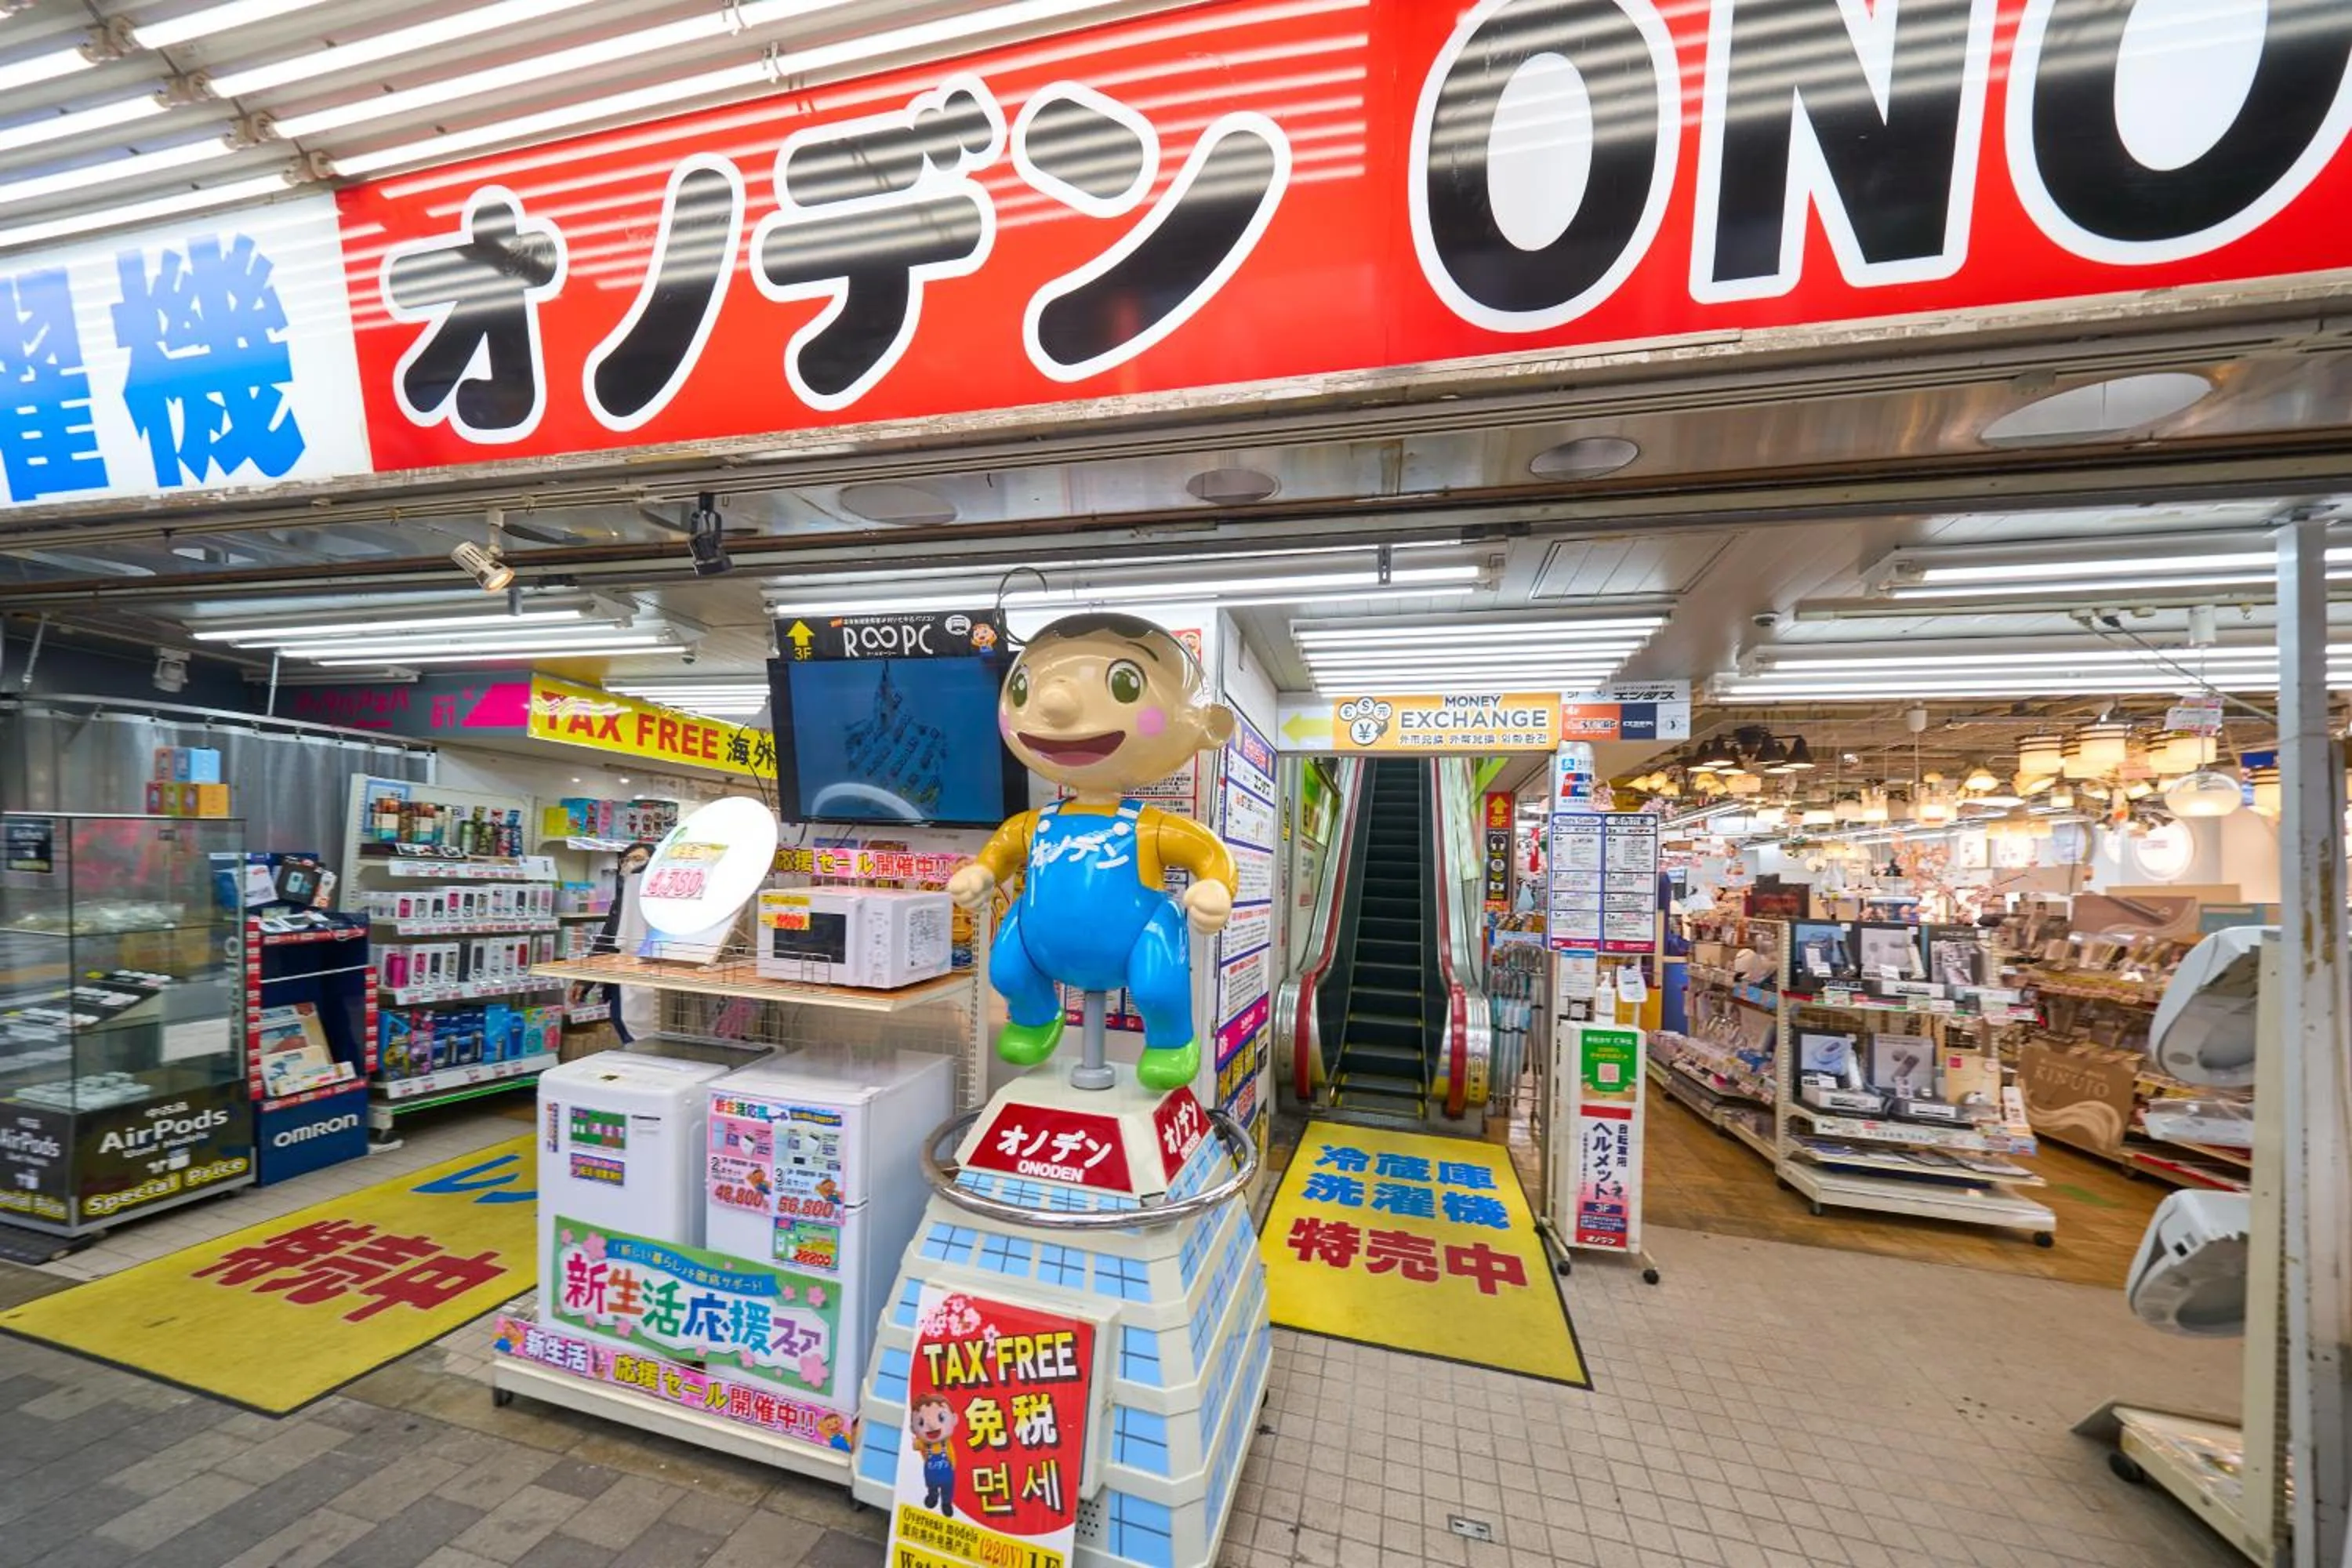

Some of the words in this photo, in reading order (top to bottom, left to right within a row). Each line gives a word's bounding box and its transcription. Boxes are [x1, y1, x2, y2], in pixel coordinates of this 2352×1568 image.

[379, 73, 1292, 443] オノデン
[793, 648, 811, 661] 3F
[540, 690, 622, 743] TAX
[635, 713, 719, 760] FREE
[1401, 710, 1548, 728] EXCHANGE
[1444, 695, 1501, 708] MONEY
[98, 1109, 229, 1154] AirPods
[996, 1124, 1112, 1168] オノデン
[1163, 1100, 1198, 1155] オノデン
[84, 1174, 177, 1214] Special
[186, 1156, 248, 1186] Price
[1017, 1160, 1086, 1182] ONODEN
[1314, 1144, 1499, 1190] 冷蔵庫
[1592, 1122, 1613, 1200] ヘルメット
[1301, 1171, 1512, 1229] 洗濯機
[1594, 1203, 1611, 1212] 3F
[191, 1219, 508, 1323] 特売中
[1287, 1217, 1529, 1296] 特売中
[564, 1252, 822, 1359] 新生活応援フェア
[526, 1330, 588, 1371] 新生活
[923, 1340, 991, 1388] TAX
[994, 1331, 1080, 1383] FREE
[965, 1392, 1058, 1448] 免税
[972, 1458, 1063, 1514] 면세
[980, 1537, 1024, 1567] (220V)
